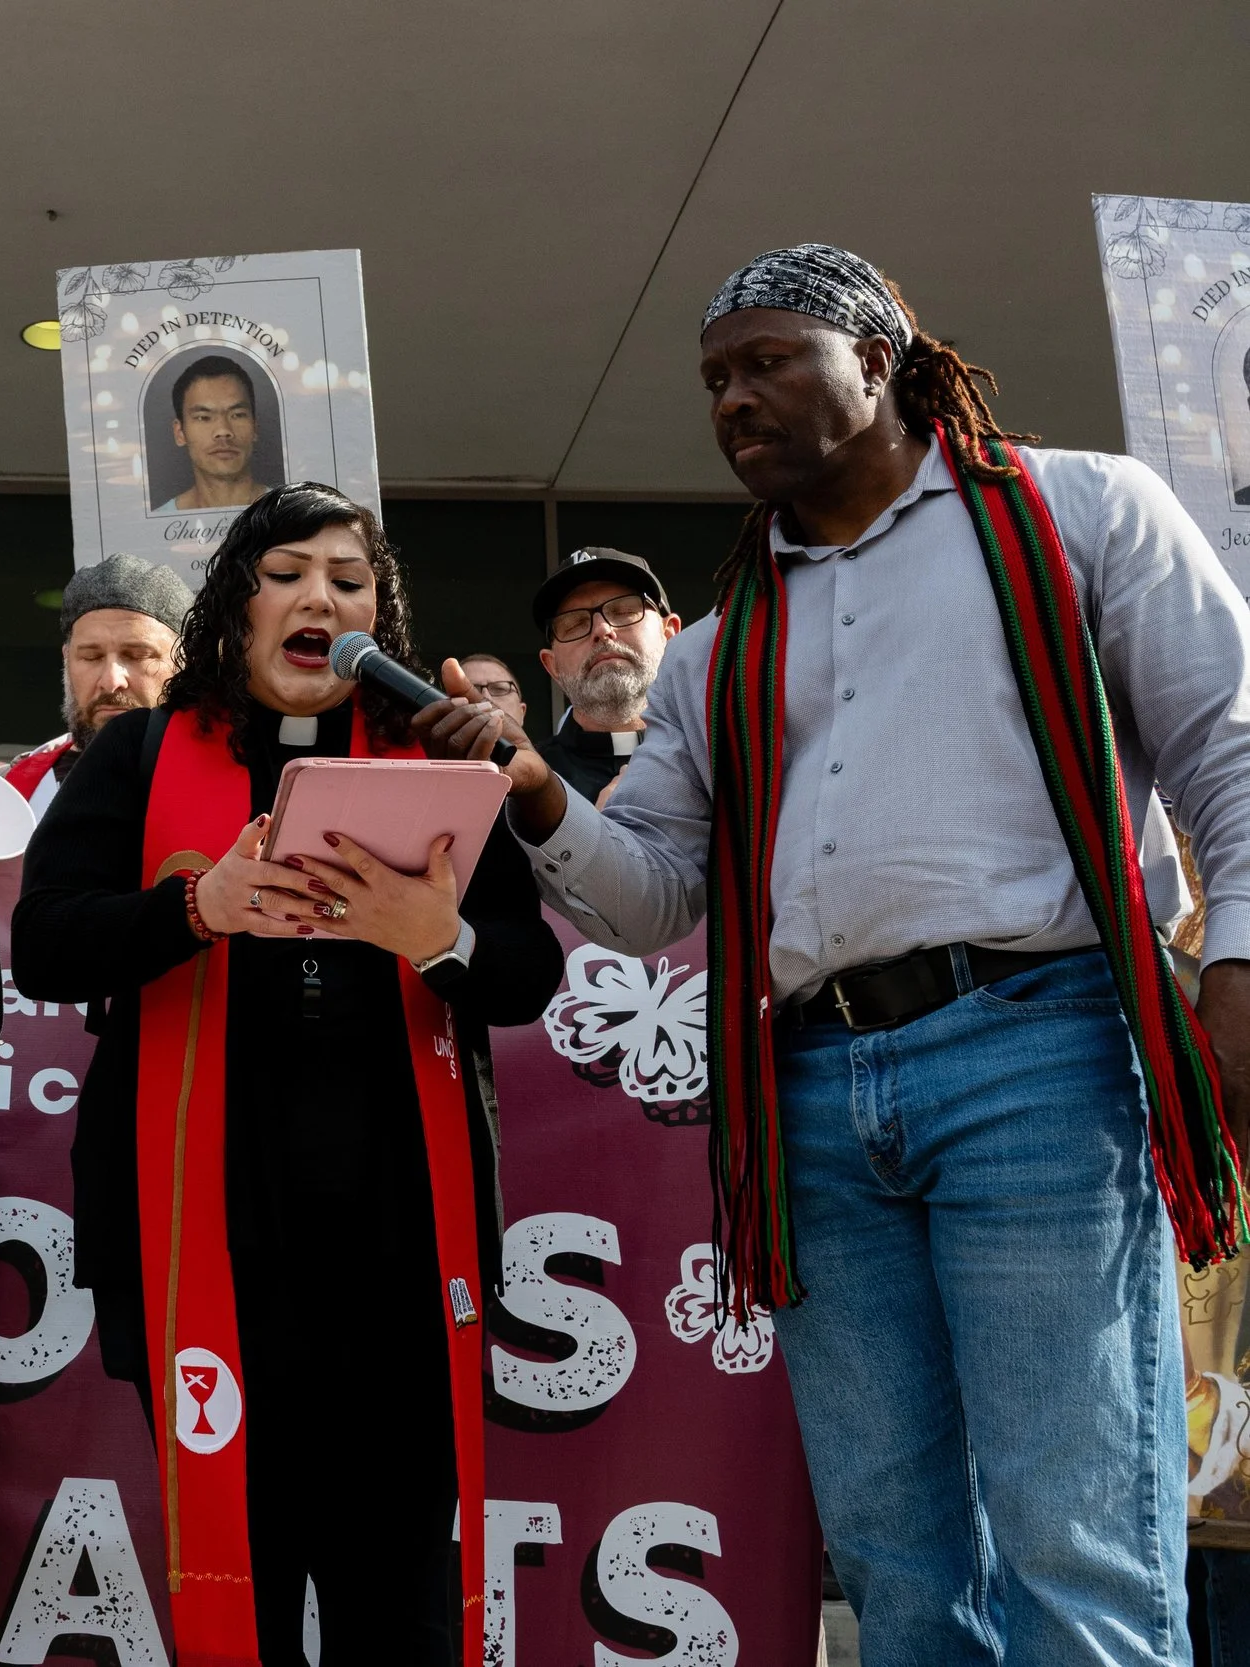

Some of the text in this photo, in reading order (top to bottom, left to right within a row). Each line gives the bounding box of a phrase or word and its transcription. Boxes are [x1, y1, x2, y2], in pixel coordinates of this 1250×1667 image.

[1191, 280, 1230, 323] DIED
[124, 312, 285, 369] DIED IN DETENTION
[164, 518, 228, 544] Chaofe
